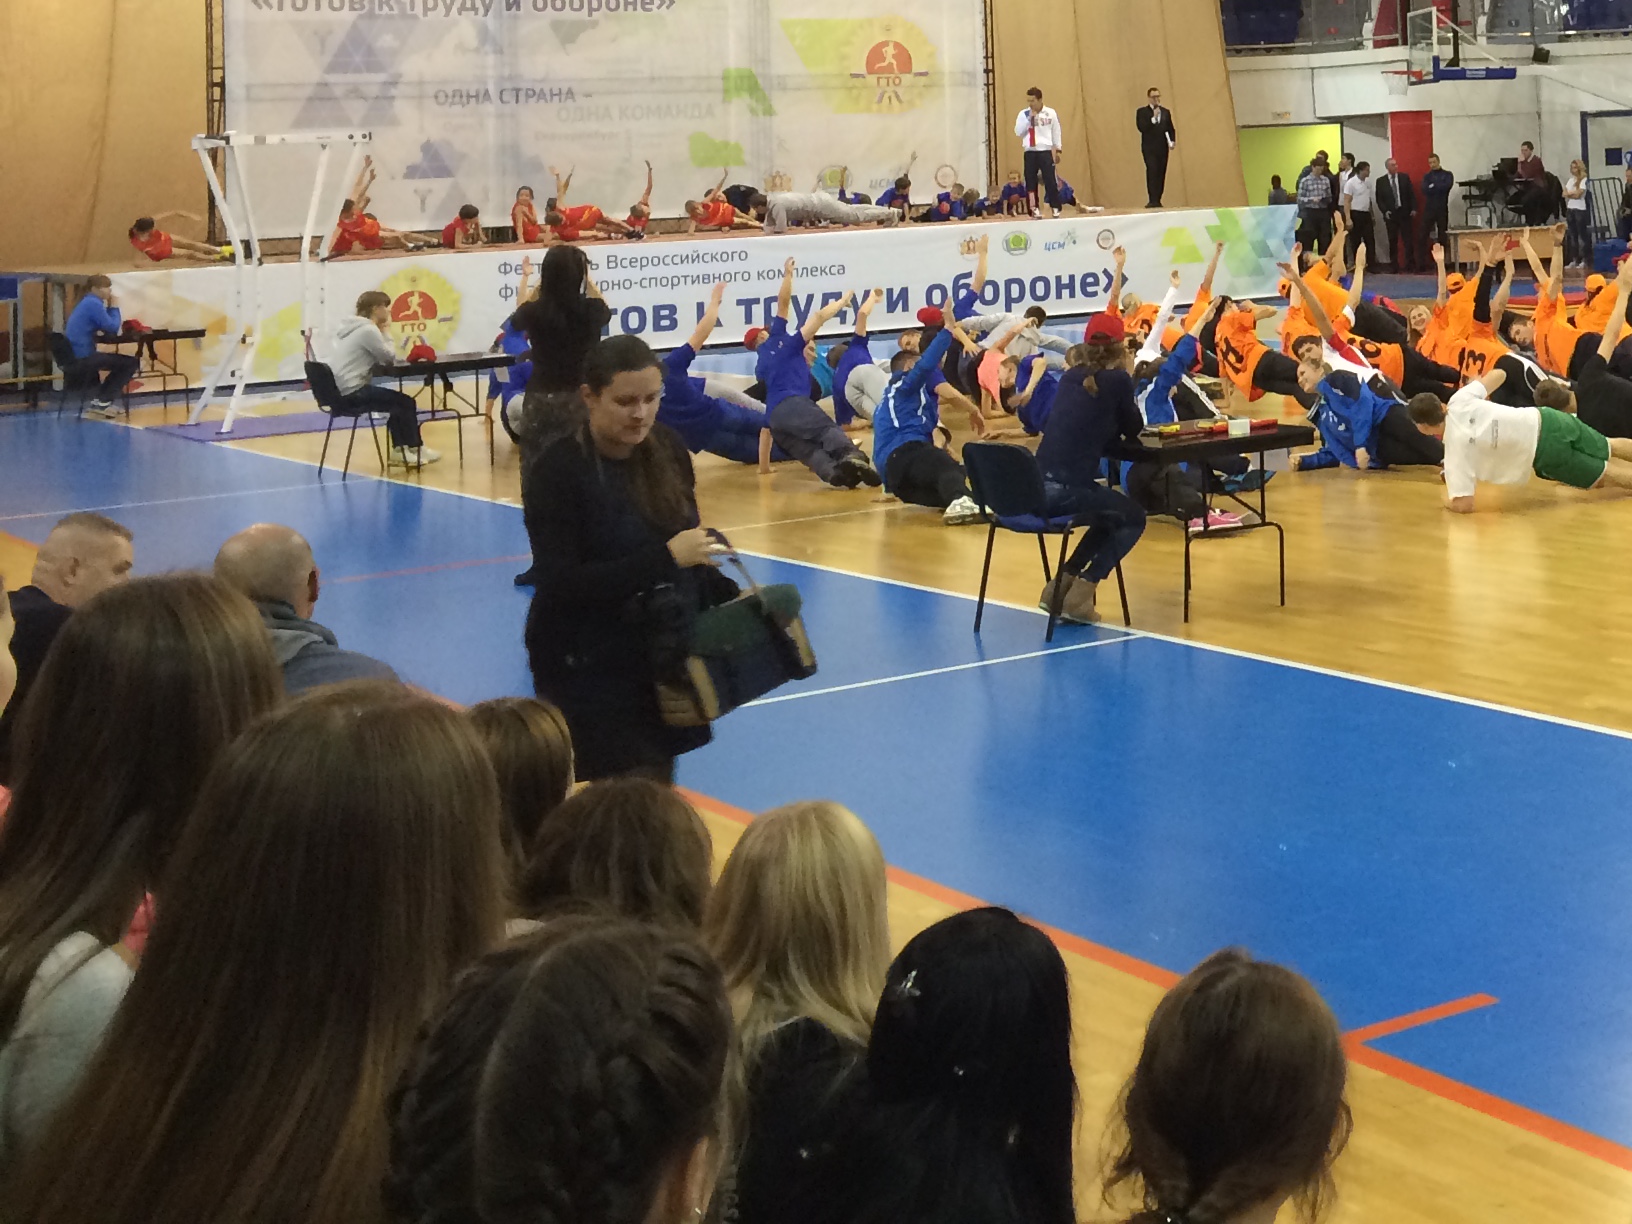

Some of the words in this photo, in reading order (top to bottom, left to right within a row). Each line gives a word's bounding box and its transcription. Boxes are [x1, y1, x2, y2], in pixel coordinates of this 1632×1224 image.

[876, 75, 902, 87] ГТО
[434, 88, 493, 108] ОДНА
[499, 87, 576, 105] СТРАНА
[557, 103, 613, 123] ОДНА
[618, 101, 716, 122] КОМАНДА
[1044, 241, 1066, 252] ЦСМ
[606, 249, 749, 272] Всероссийского
[886, 286, 909, 314] и
[925, 267, 1129, 313] обороне»
[401, 322, 427, 333] ГТО
